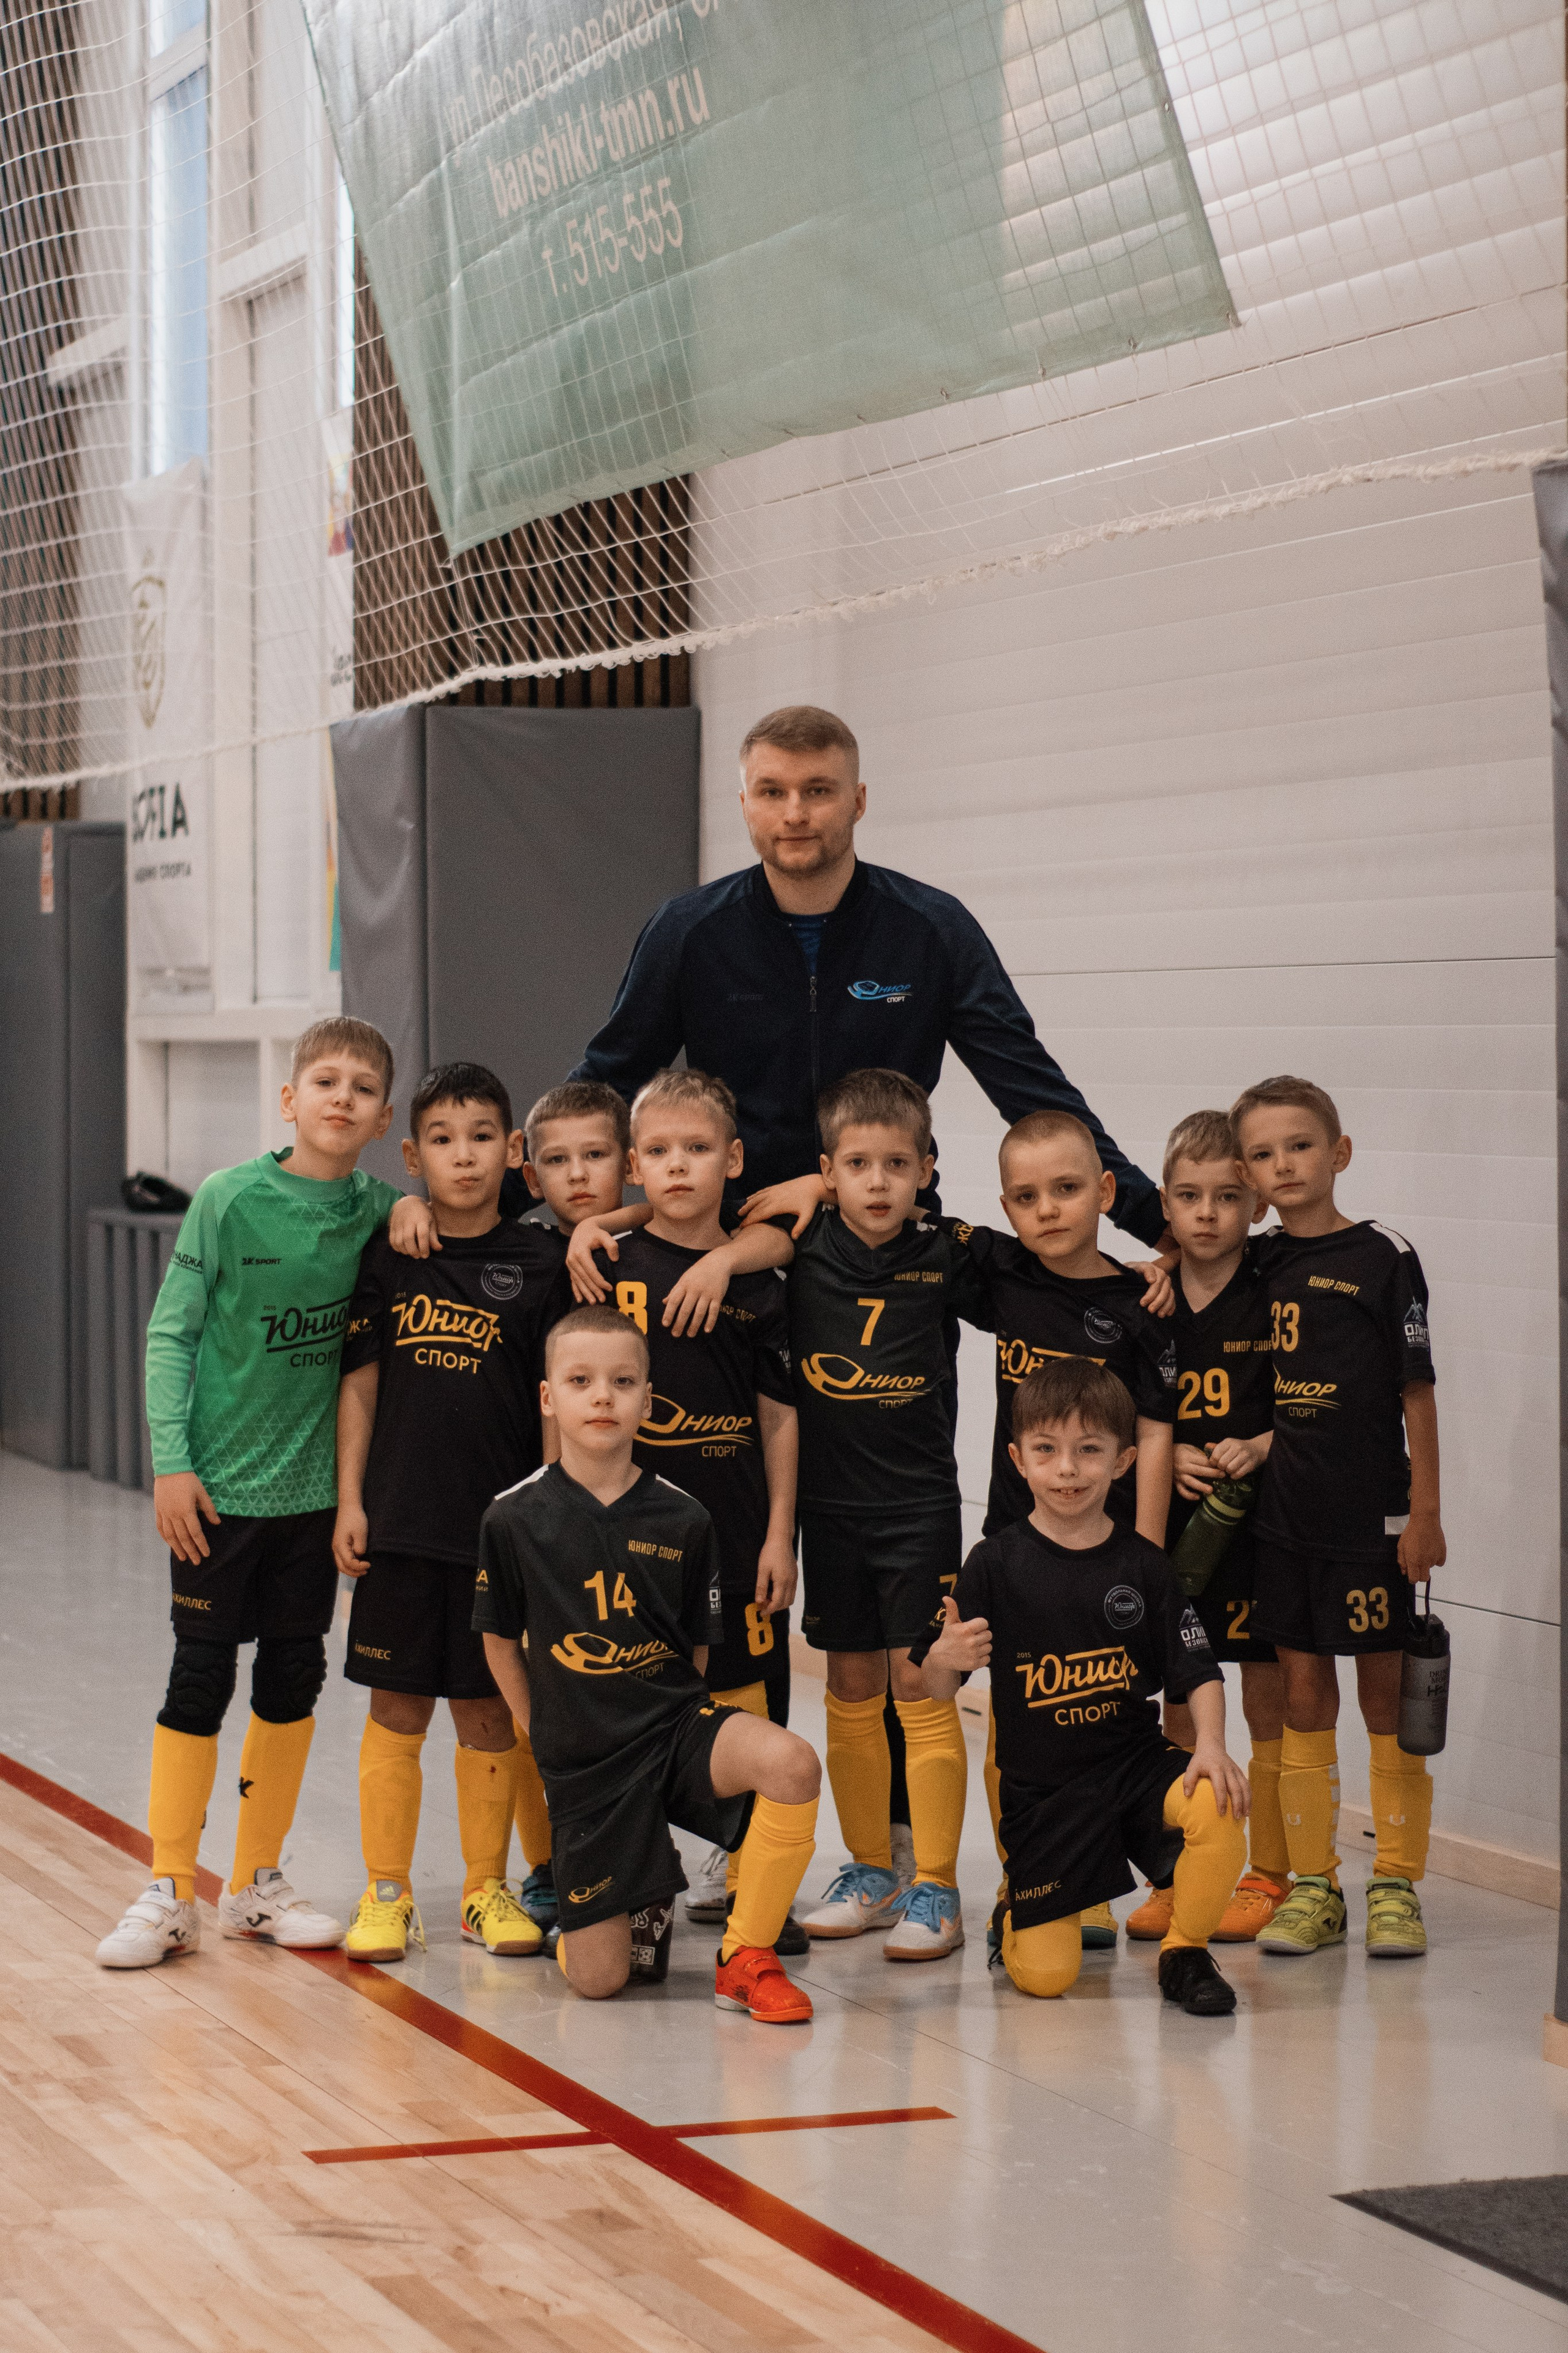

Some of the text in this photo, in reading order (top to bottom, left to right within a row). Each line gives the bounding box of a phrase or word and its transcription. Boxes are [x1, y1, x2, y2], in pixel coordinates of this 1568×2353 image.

[565, 176, 684, 286] 515-555
[922, 1272, 943, 1283] СПОРТ
[1308, 1275, 1360, 1296] ЮНИОР СПОРТ
[261, 1296, 351, 1350] Юнио
[392, 1294, 503, 1351] Юниор
[616, 1280, 647, 1335] 8
[858, 1297, 885, 1346] 7
[1271, 1301, 1300, 1352] 33
[415, 1348, 481, 1374] СПОРТ
[1224, 1340, 1272, 1353] ЮНИОР СПОР
[1177, 1368, 1231, 1420] 29
[1289, 1407, 1317, 1418] СПОРТ
[702, 1446, 736, 1457] СПОРТ
[628, 1539, 683, 1562] ЮНИОР СПОРТ
[584, 1570, 637, 1621] 14
[1346, 1587, 1389, 1633] 33
[745, 1603, 774, 1656] 8
[636, 1663, 664, 1679] СПОРТ
[1016, 1645, 1139, 1699] Юниор
[1055, 1701, 1121, 1726] СПОРТ
[1015, 1879, 1061, 1901] АХИЛЛЕС
